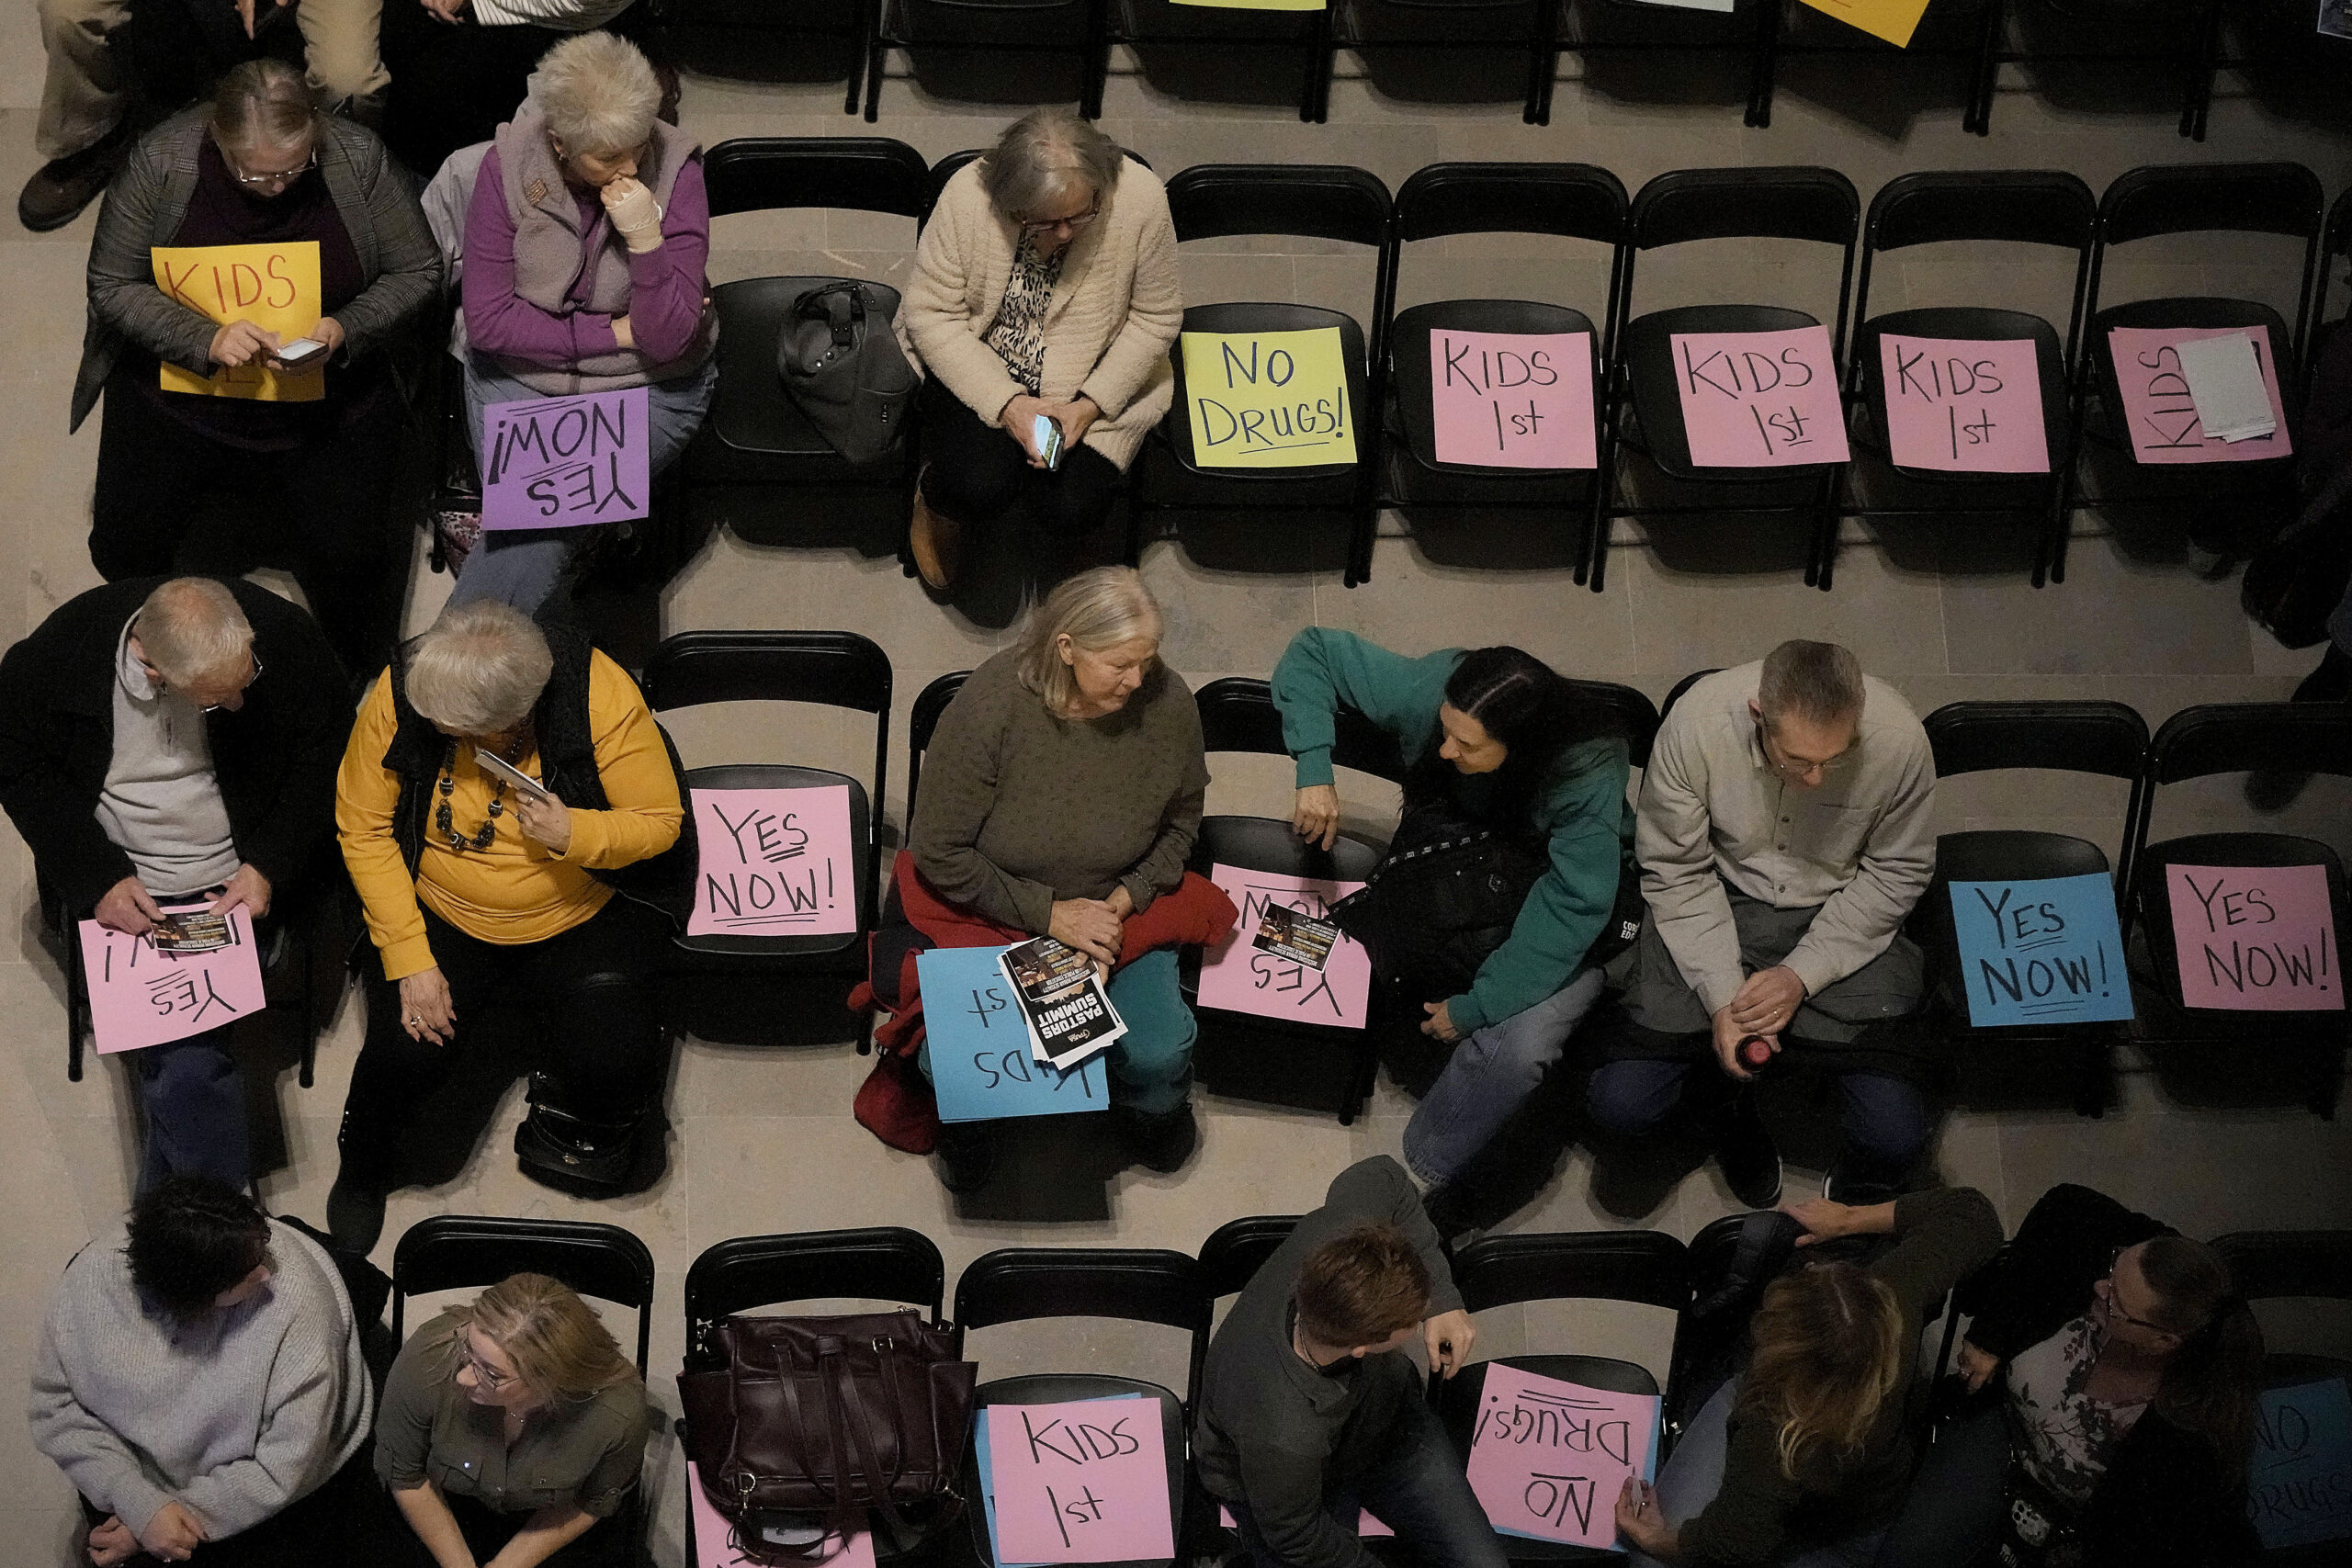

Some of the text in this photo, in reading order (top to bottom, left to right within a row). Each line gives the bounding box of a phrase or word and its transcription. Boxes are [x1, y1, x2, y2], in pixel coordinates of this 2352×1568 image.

[164, 254, 296, 316] KIDS
[1221, 339, 1295, 389] NO
[1444, 337, 1560, 395] KIDS
[1682, 340, 1815, 400] KIDS
[1896, 344, 2005, 403] KIDS
[1197, 386, 1345, 447] DRUGS!
[1492, 399, 1545, 451] 1st
[2137, 345, 2204, 449] KIDS
[487, 399, 626, 486] NOW!
[1750, 403, 1814, 456] 1st
[1949, 405, 1997, 460] 1st
[526, 451, 638, 516] YES
[711, 803, 809, 864] YES
[706, 857, 835, 917] NOW!
[2184, 874, 2277, 933] YES
[1974, 887, 2065, 950] YES
[1250, 953, 1343, 1017] YES
[1980, 940, 2110, 1006] NOW!
[2203, 926, 2329, 994] NOW!
[151, 969, 238, 1022] YES
[1037, 992, 1098, 1028] SUMMIT
[1041, 1004, 1104, 1040] PASTORS
[1022, 1411, 1140, 1465] KIDS
[1473, 1394, 1632, 1467] DRUGS!
[1046, 1484, 1104, 1549] 1st
[1524, 1479, 1596, 1536] NO
